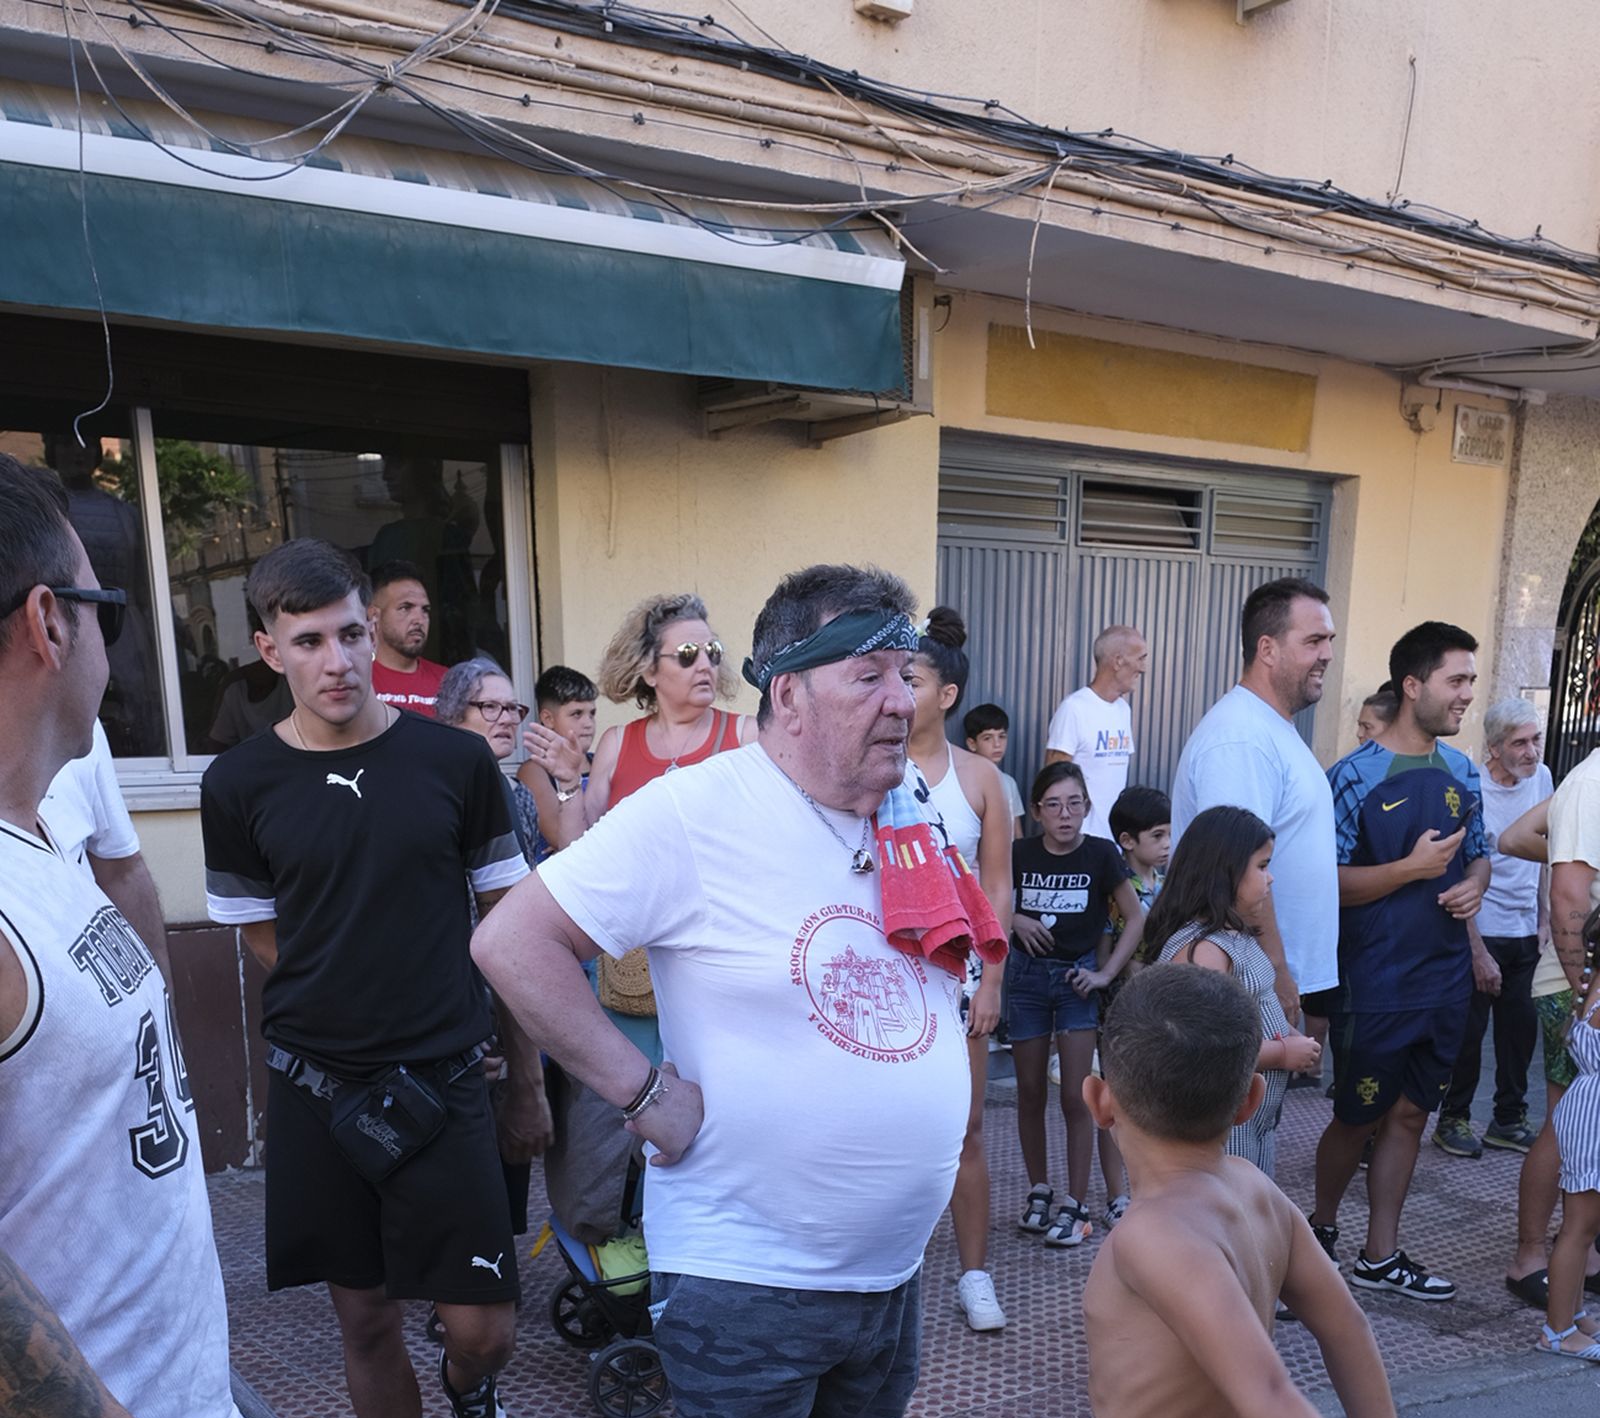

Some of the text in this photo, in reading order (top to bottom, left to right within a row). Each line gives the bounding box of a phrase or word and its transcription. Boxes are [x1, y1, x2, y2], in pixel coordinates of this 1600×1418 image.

[1021, 872, 1091, 888] LIMITED
[1023, 893, 1086, 911] edition
[819, 904, 880, 926] CULTURAL
[808, 1013, 819, 1023] Y
[817, 1023, 900, 1064] CABEZUDOS
[902, 1052, 918, 1063] DE
